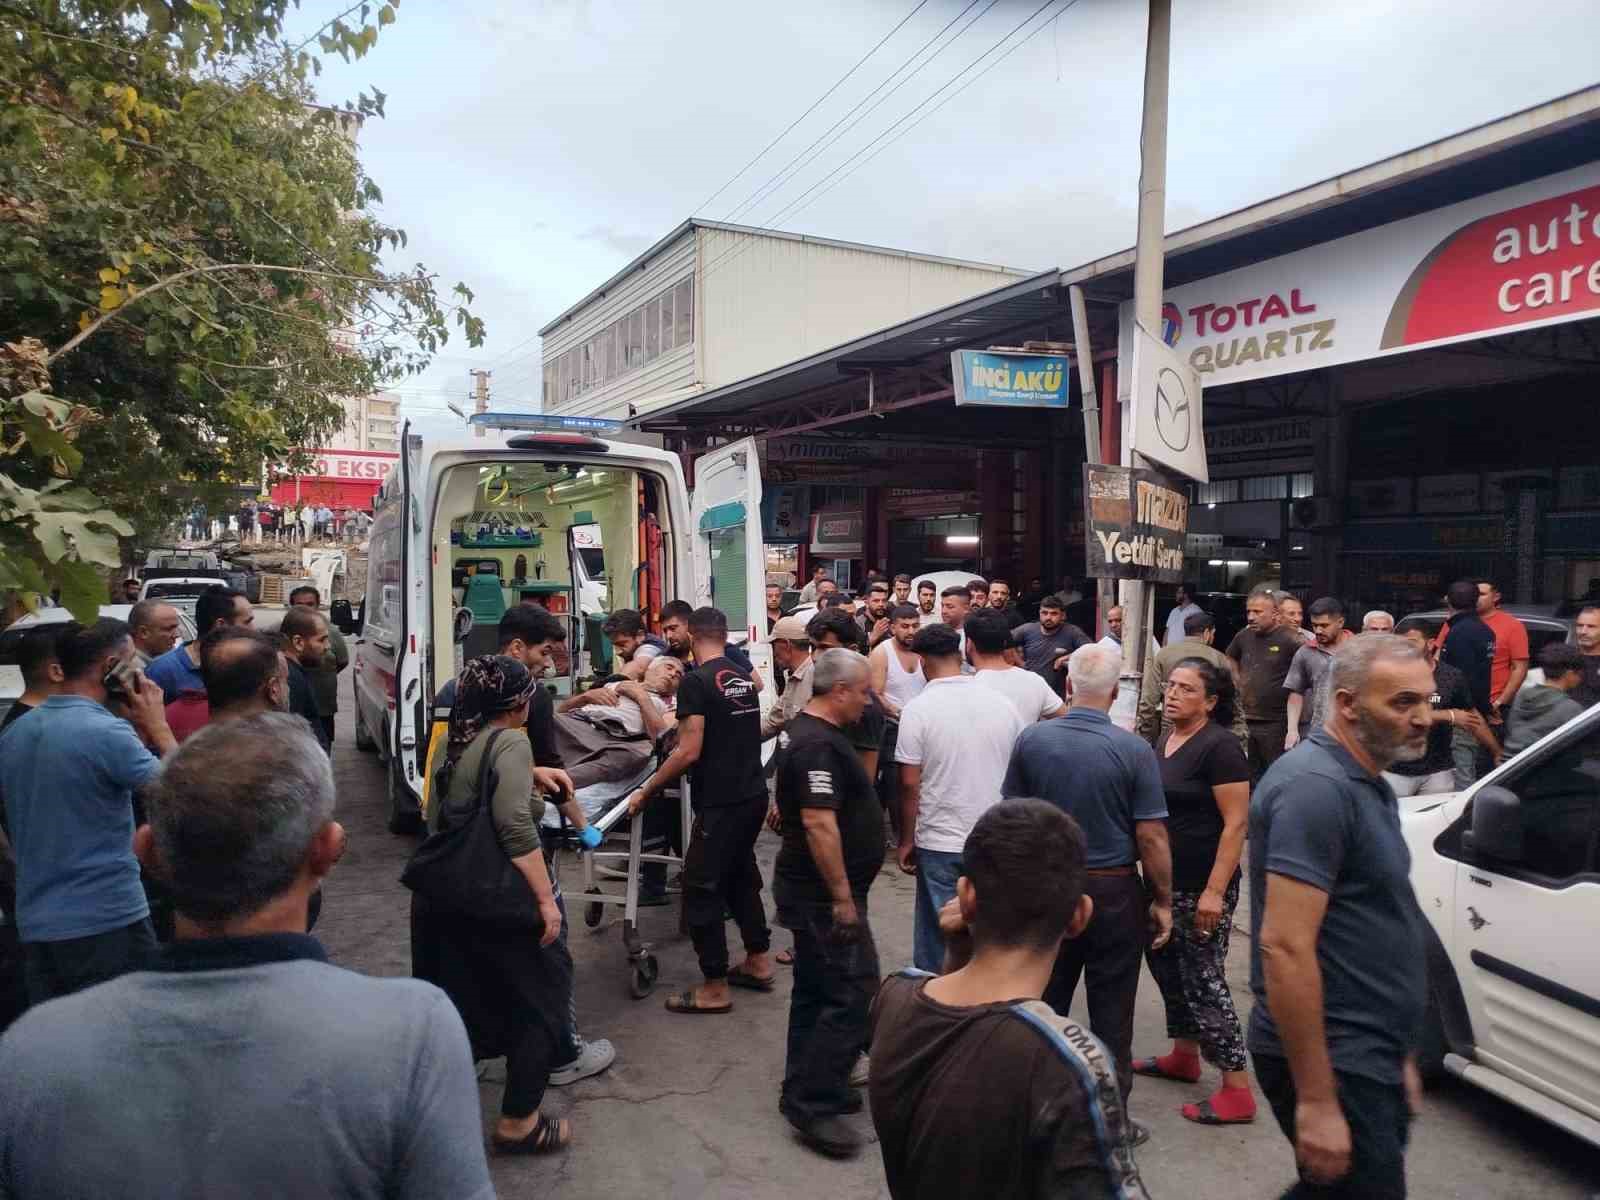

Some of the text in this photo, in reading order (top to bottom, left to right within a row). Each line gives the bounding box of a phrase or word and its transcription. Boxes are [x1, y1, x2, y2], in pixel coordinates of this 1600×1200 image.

[1189, 288, 1317, 337] TOTAL
[1189, 319, 1336, 373] QUARTZ
[1012, 363, 1063, 392] AKÜ
